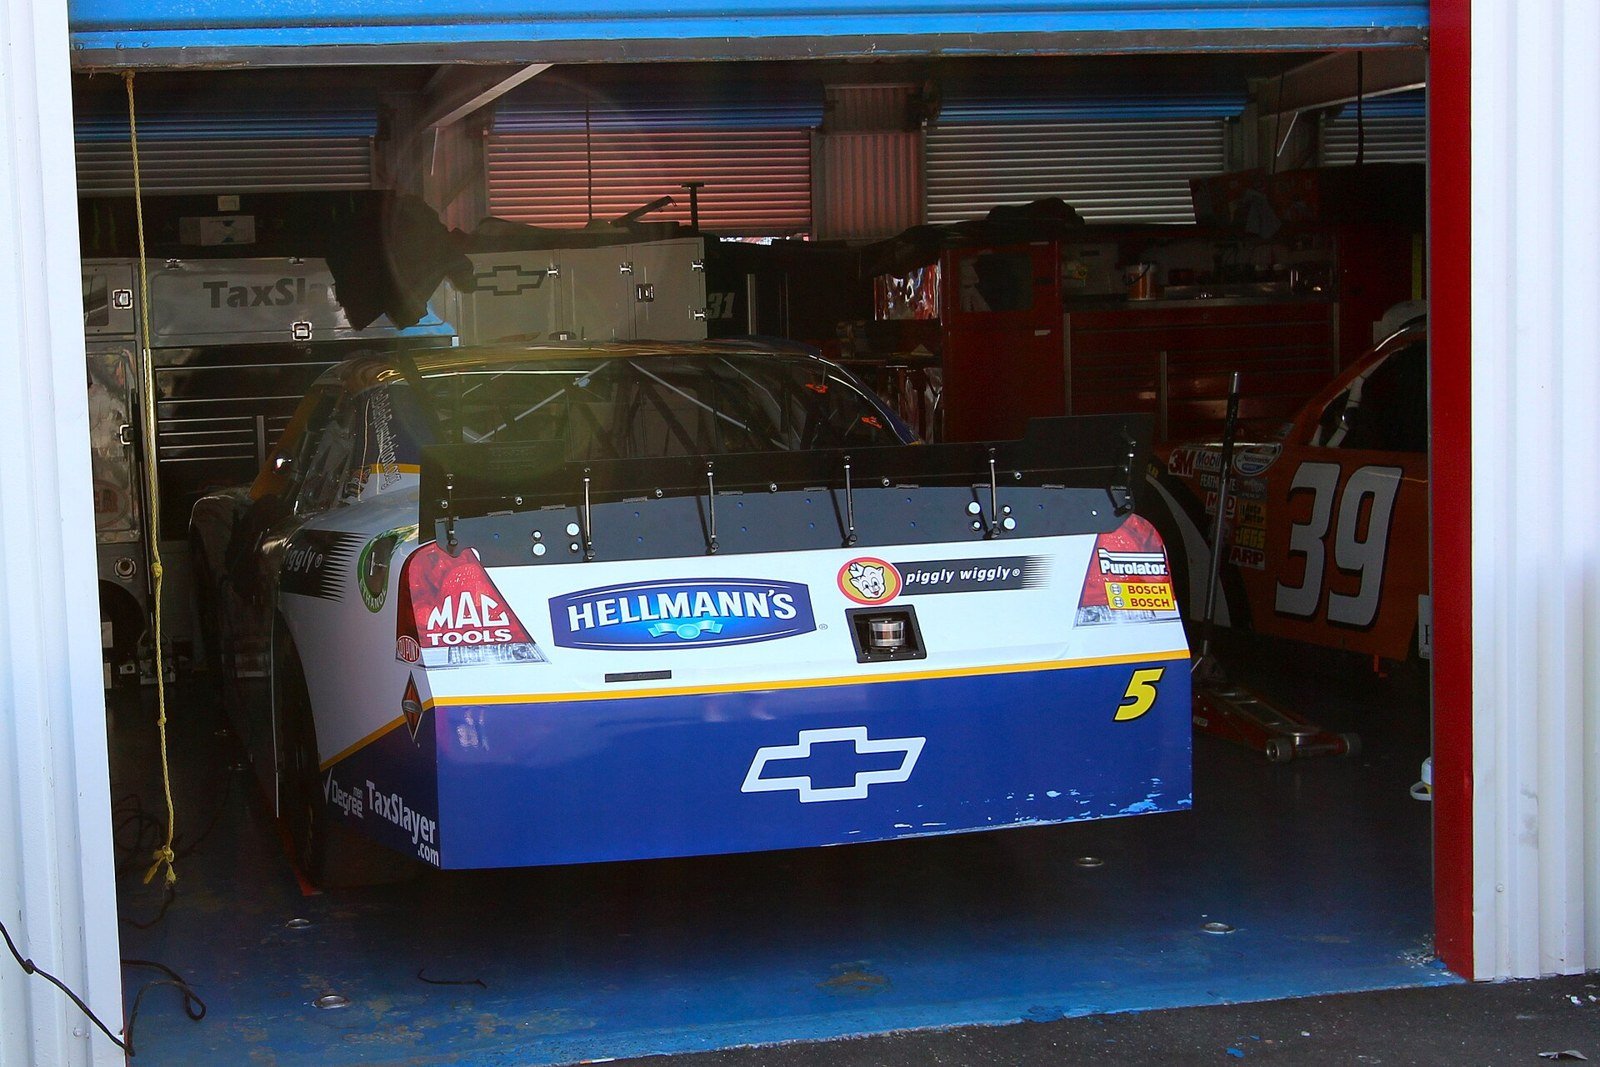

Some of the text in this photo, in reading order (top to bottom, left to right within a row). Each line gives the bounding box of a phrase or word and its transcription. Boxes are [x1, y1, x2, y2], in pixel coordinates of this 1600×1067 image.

[707, 292, 735, 319] 31
[1170, 449, 1193, 477] 3M
[1275, 461, 1402, 628] 39
[905, 568, 955, 586] piggly
[1128, 585, 1167, 595] BOSCH
[427, 591, 510, 630] MAC
[567, 590, 797, 632] HELLMANN'S
[1131, 598, 1170, 607] BOSCH
[427, 628, 513, 646] TOOLS
[1113, 666, 1166, 722] 5
[332, 779, 364, 819] Degree
[366, 779, 436, 845] TaxSlayer
[417, 842, 440, 867] .com
